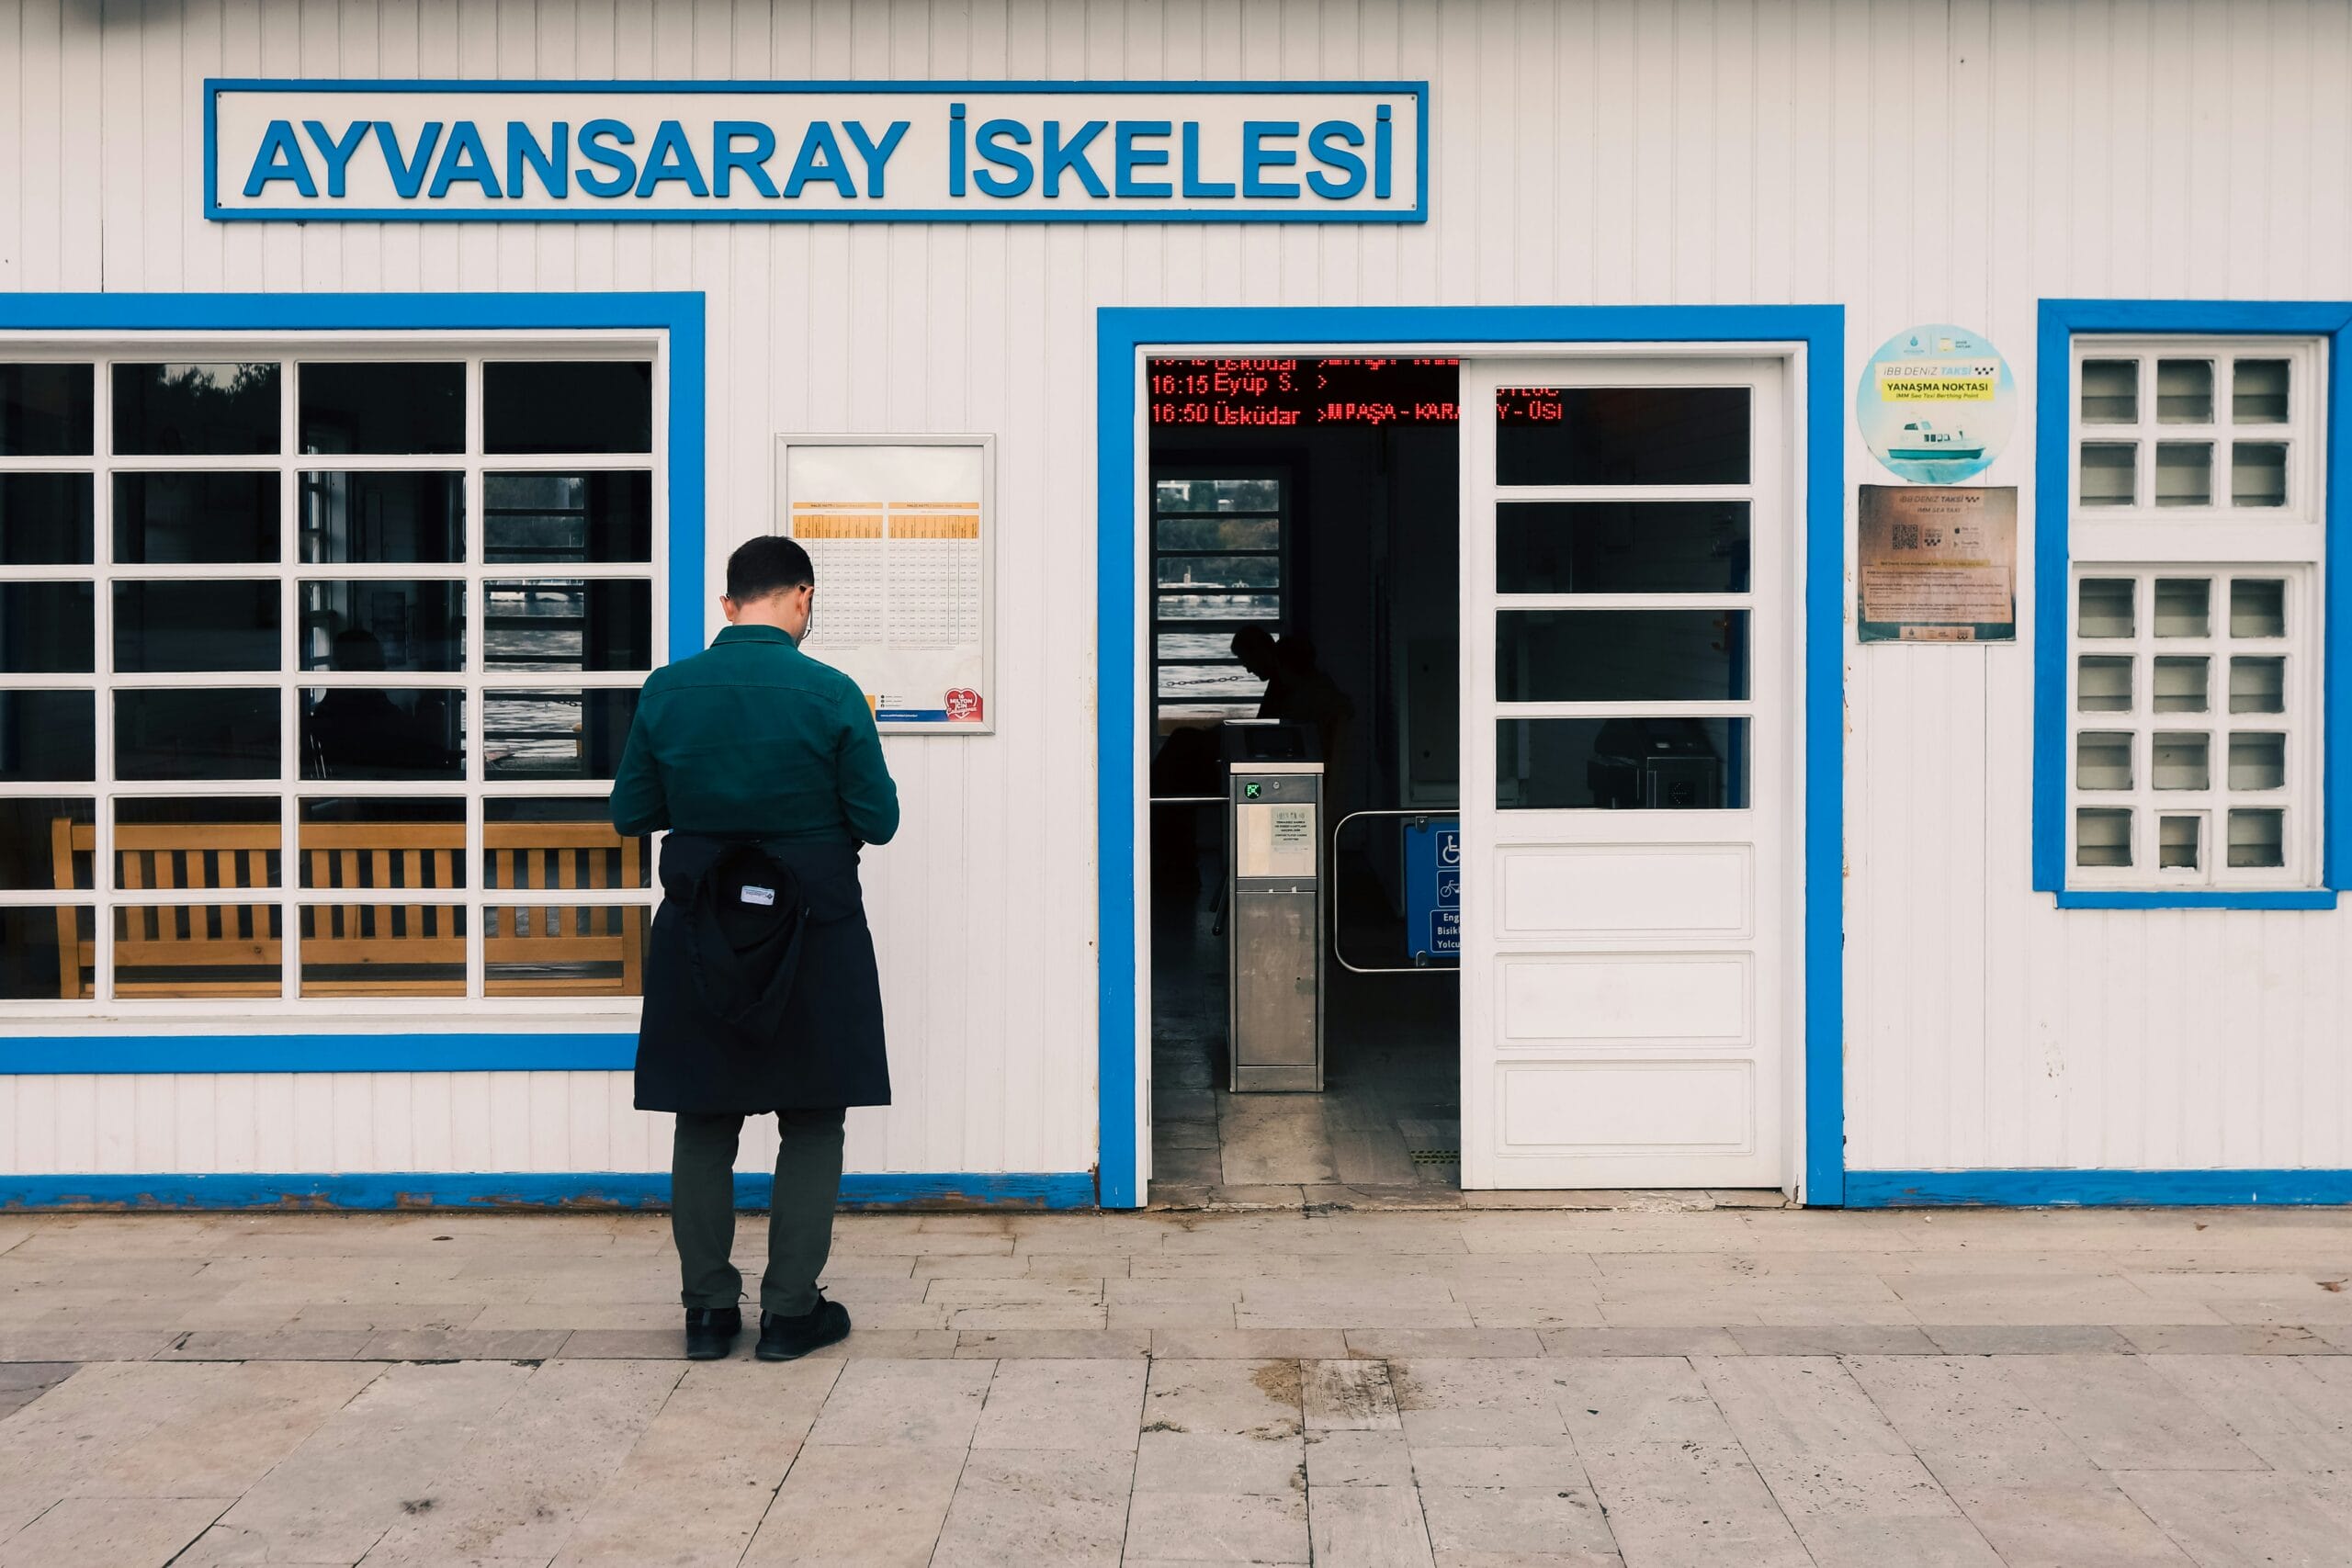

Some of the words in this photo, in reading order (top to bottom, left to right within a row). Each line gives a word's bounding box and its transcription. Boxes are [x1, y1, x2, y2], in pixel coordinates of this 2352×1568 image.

[243, 119, 910, 198] AYVANSARAY
[949, 103, 1392, 198] İSKELESİ
[1153, 374, 1209, 395] 16:15
[1214, 371, 1269, 397] Eyüp
[1278, 371, 1299, 392] S.
[1887, 382, 1939, 392] YANAŞMA
[1942, 382, 1988, 391] NOKTASI
[1153, 402, 1209, 423] 16:50
[1214, 400, 1301, 425] Üsküdar
